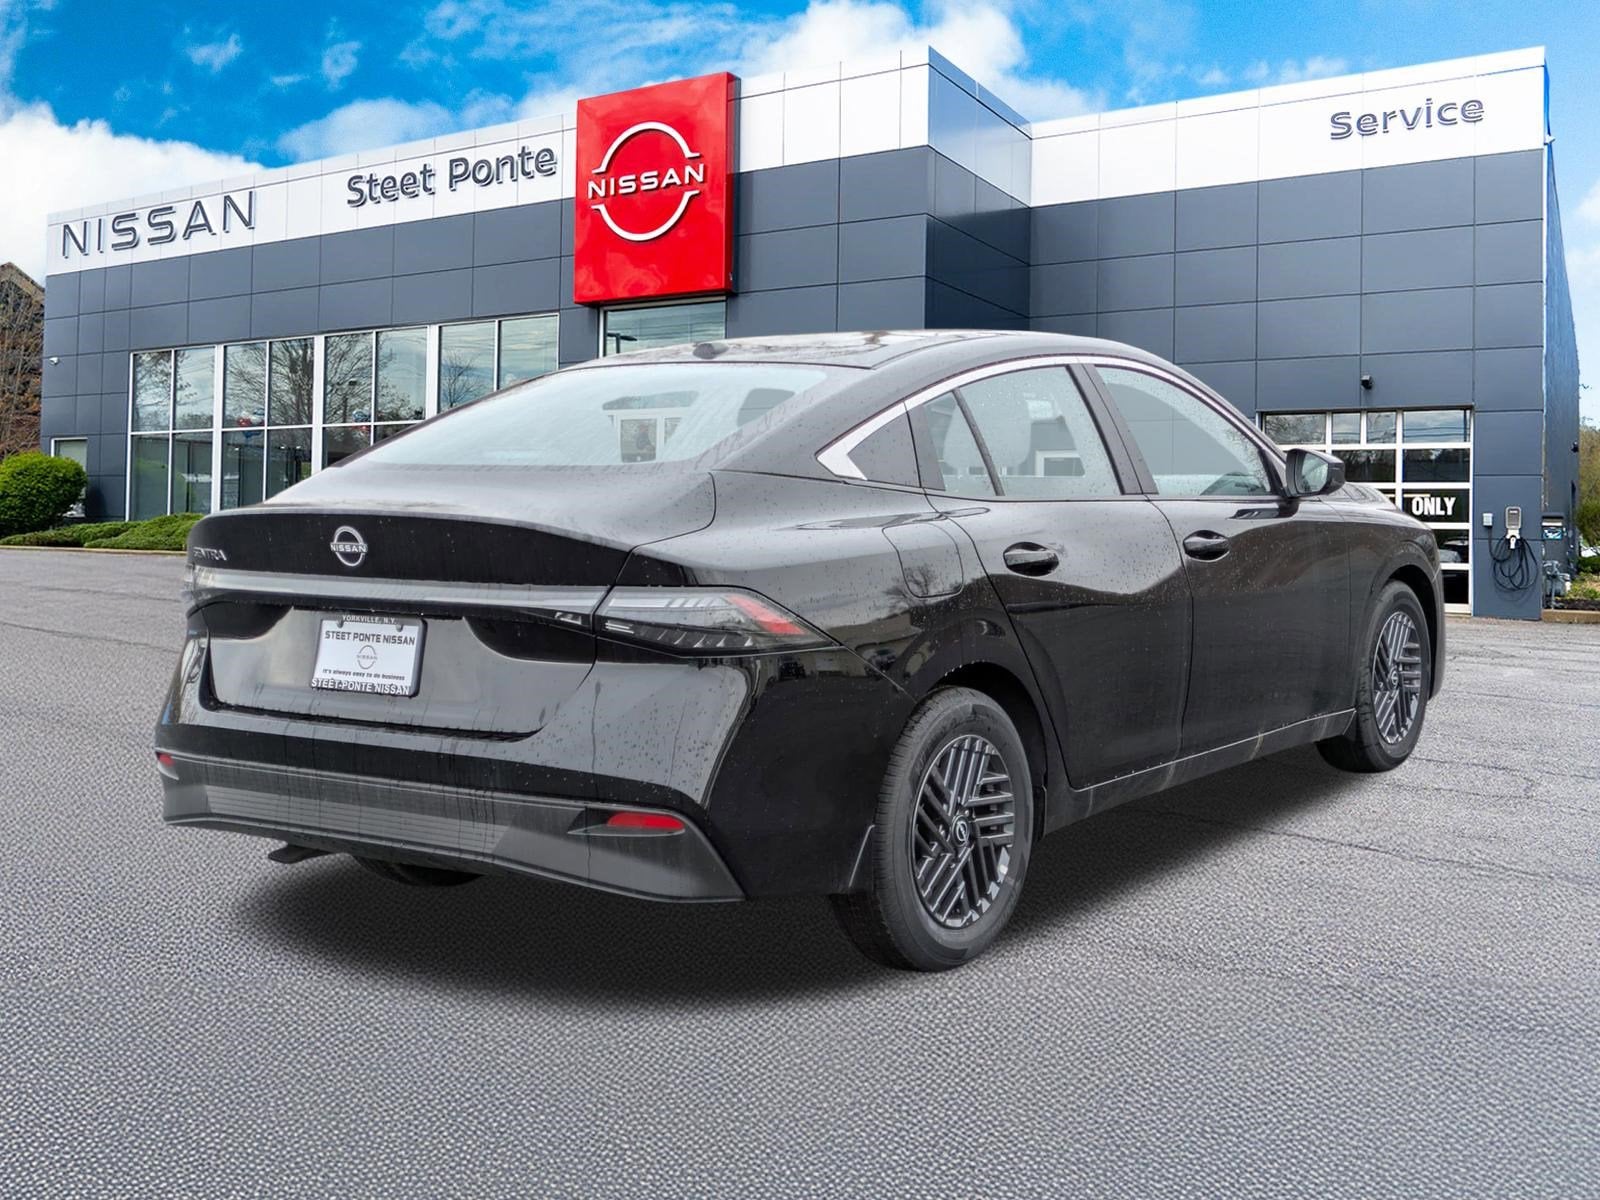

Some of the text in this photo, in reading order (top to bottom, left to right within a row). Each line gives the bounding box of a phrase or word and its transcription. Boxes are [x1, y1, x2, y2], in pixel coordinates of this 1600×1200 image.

[1330, 98, 1485, 140] Service
[347, 146, 557, 207] Steet Ponte
[587, 163, 705, 199] NISSAN
[63, 190, 255, 259] NISSAN
[1411, 496, 1456, 516] ONLY
[330, 543, 368, 553] NISSAN
[325, 630, 416, 646] STEET PONTE NISSAN
[382, 673, 405, 681] business
[374, 683, 410, 695] NISSAN
